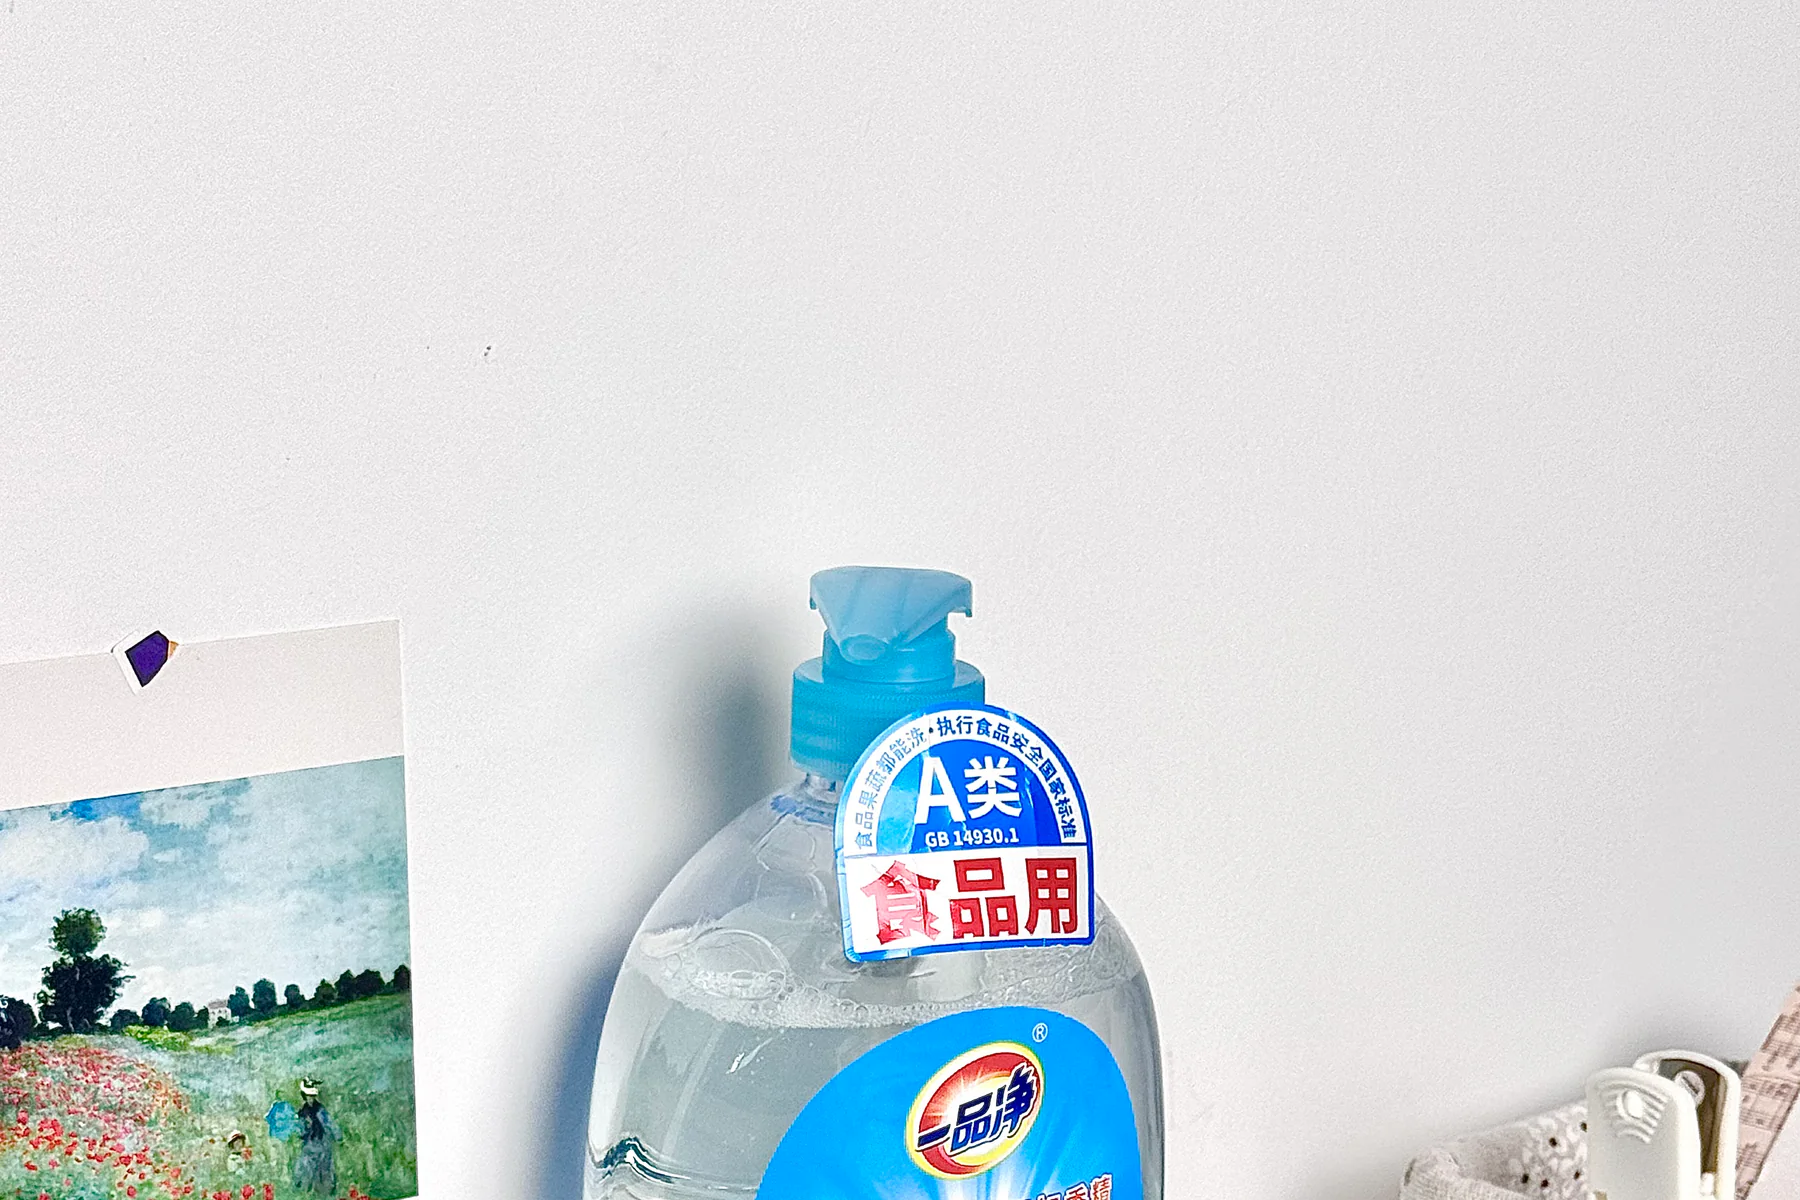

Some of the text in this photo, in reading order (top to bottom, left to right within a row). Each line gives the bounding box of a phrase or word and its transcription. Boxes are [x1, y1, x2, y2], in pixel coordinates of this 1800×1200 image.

[914, 755, 1022, 825] A类
[925, 827, 1020, 848] GB 14930.1
[860, 857, 1078, 945] 食品用
[916, 1063, 1038, 1152] 一品净
